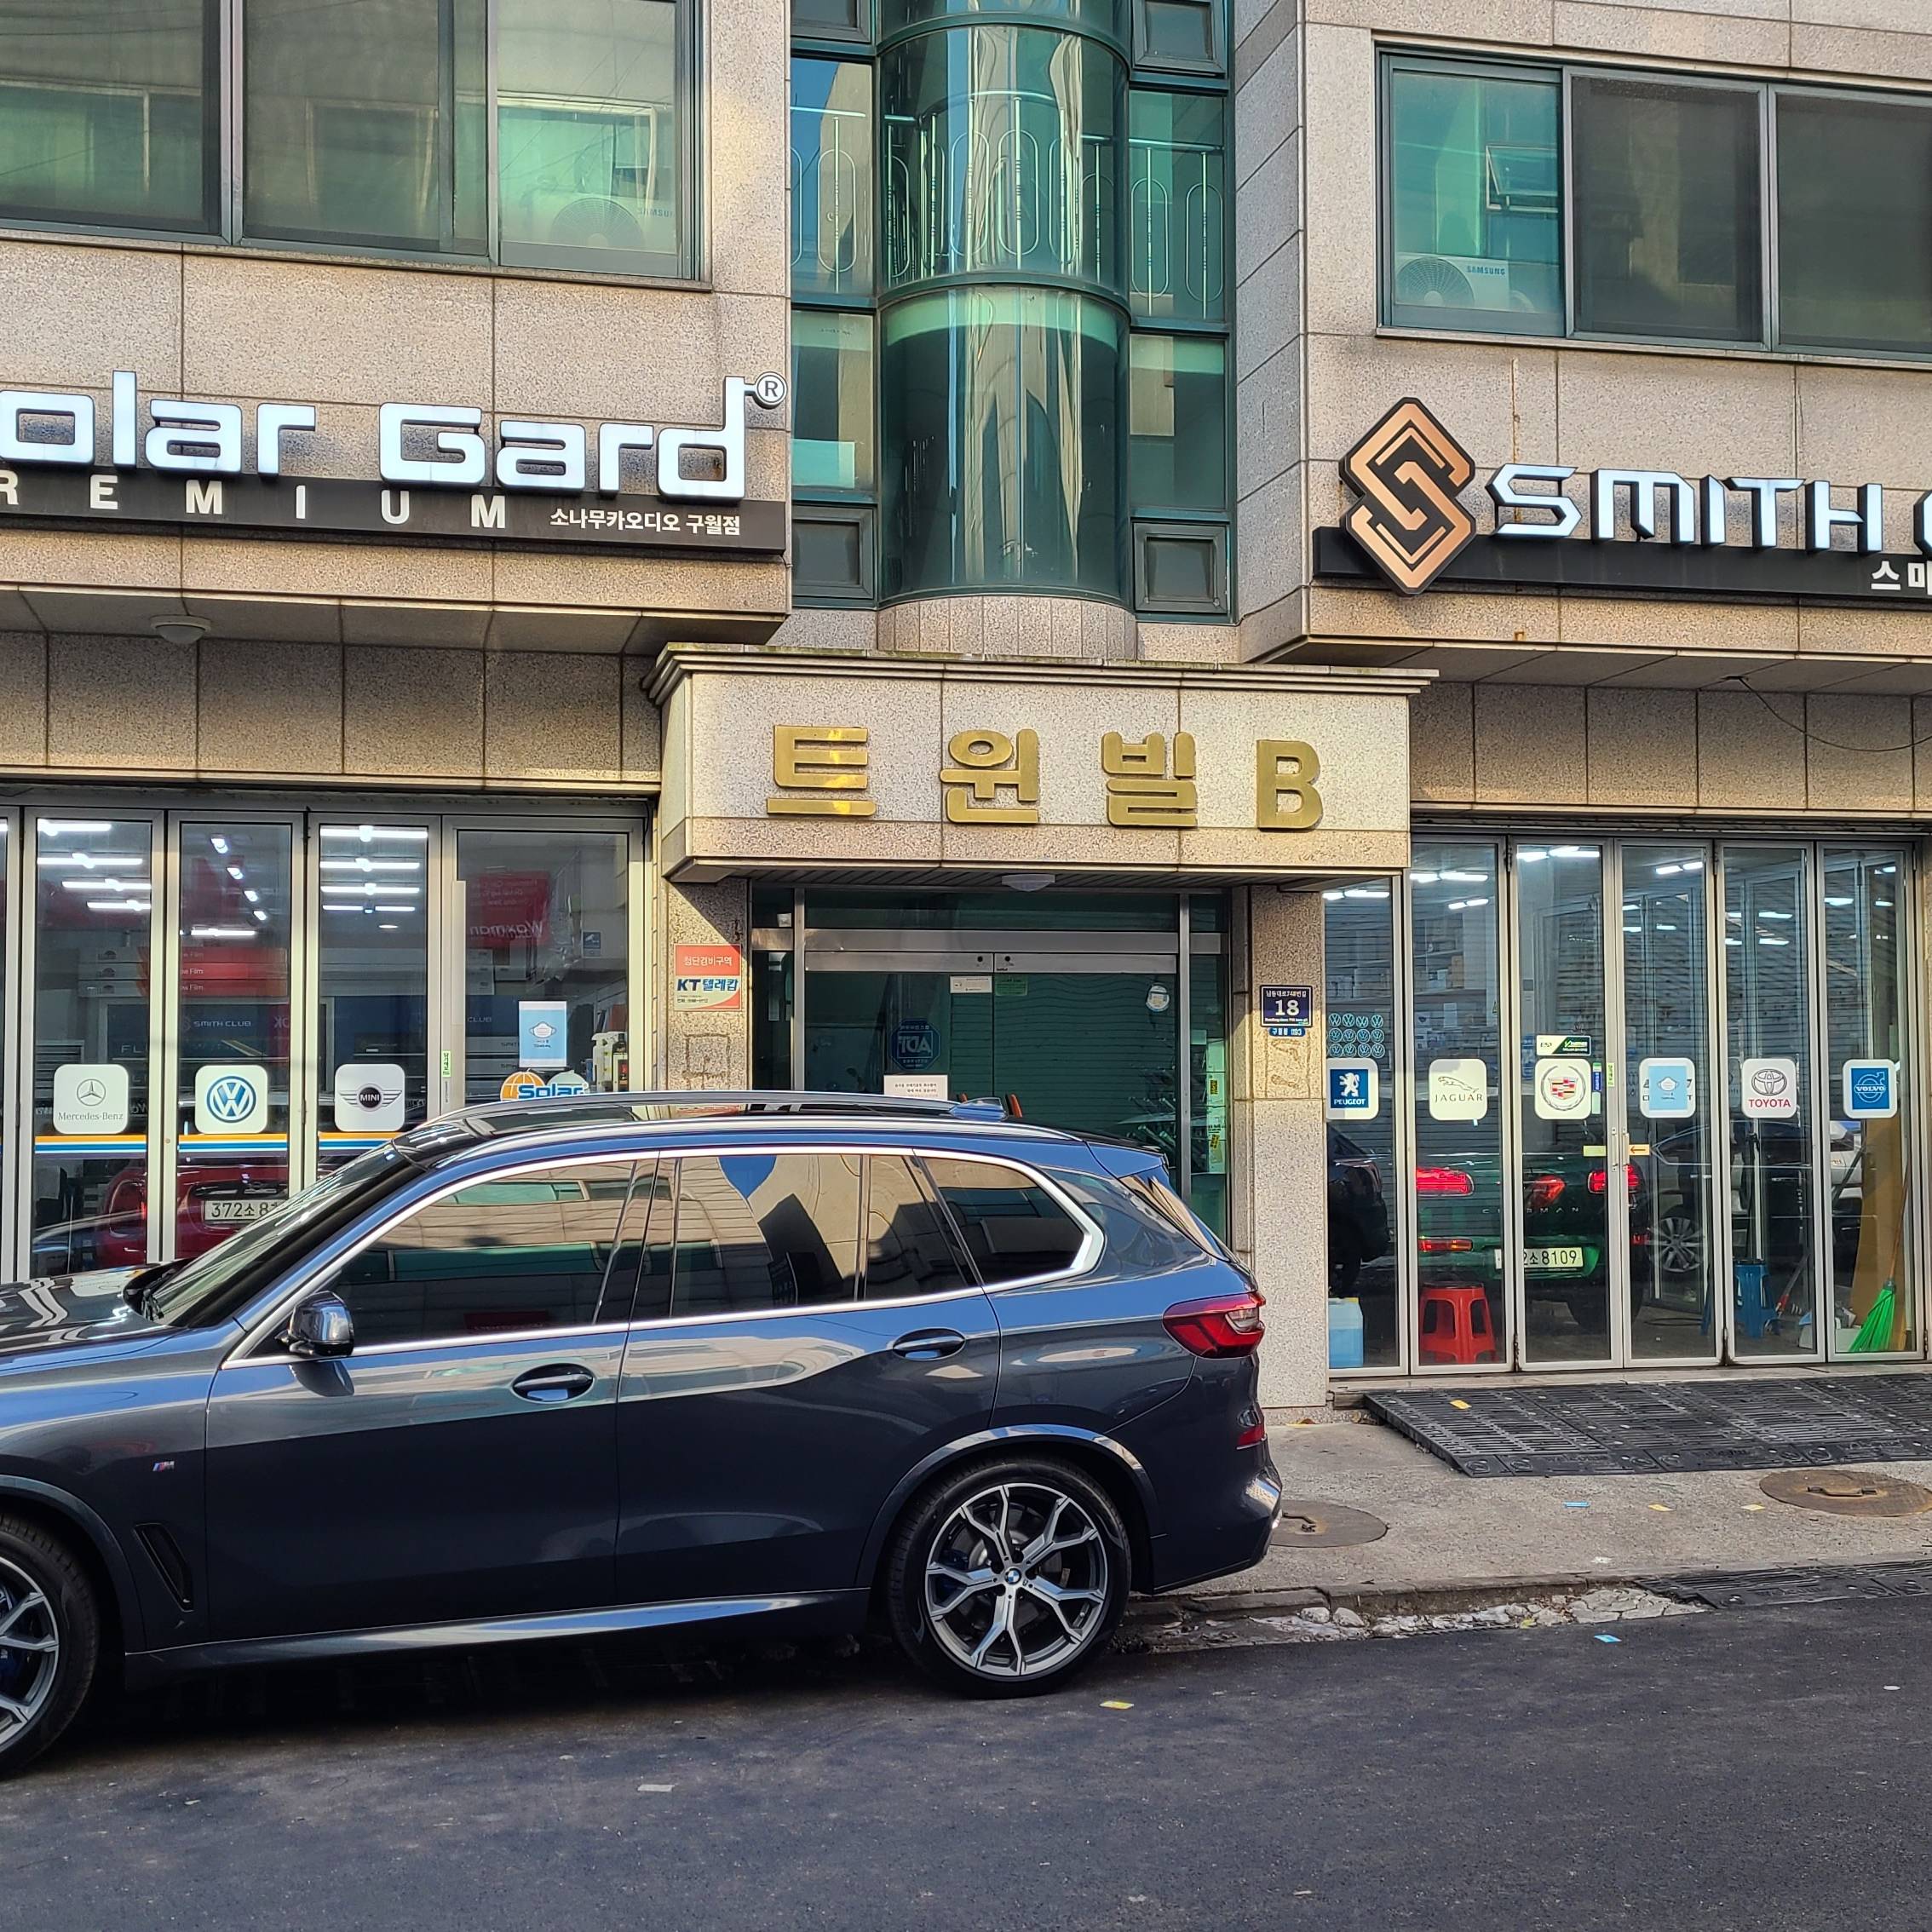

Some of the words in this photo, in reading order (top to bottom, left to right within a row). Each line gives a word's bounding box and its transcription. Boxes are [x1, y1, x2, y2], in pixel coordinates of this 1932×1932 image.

[1467, 265, 1506, 275] SAMSUNG
[1486, 463, 1883, 554] SMITH
[549, 509, 681, 532] 소나무카오디오
[686, 515, 740, 536] 구월점
[1275, 999, 1300, 1016] 18
[1855, 1084, 1886, 1093] VOLVO
[1435, 1094, 1483, 1102] JAGUAR
[1749, 1099, 1791, 1108] TOYOTA
[58, 1112, 124, 1121] Mercedes-Benz
